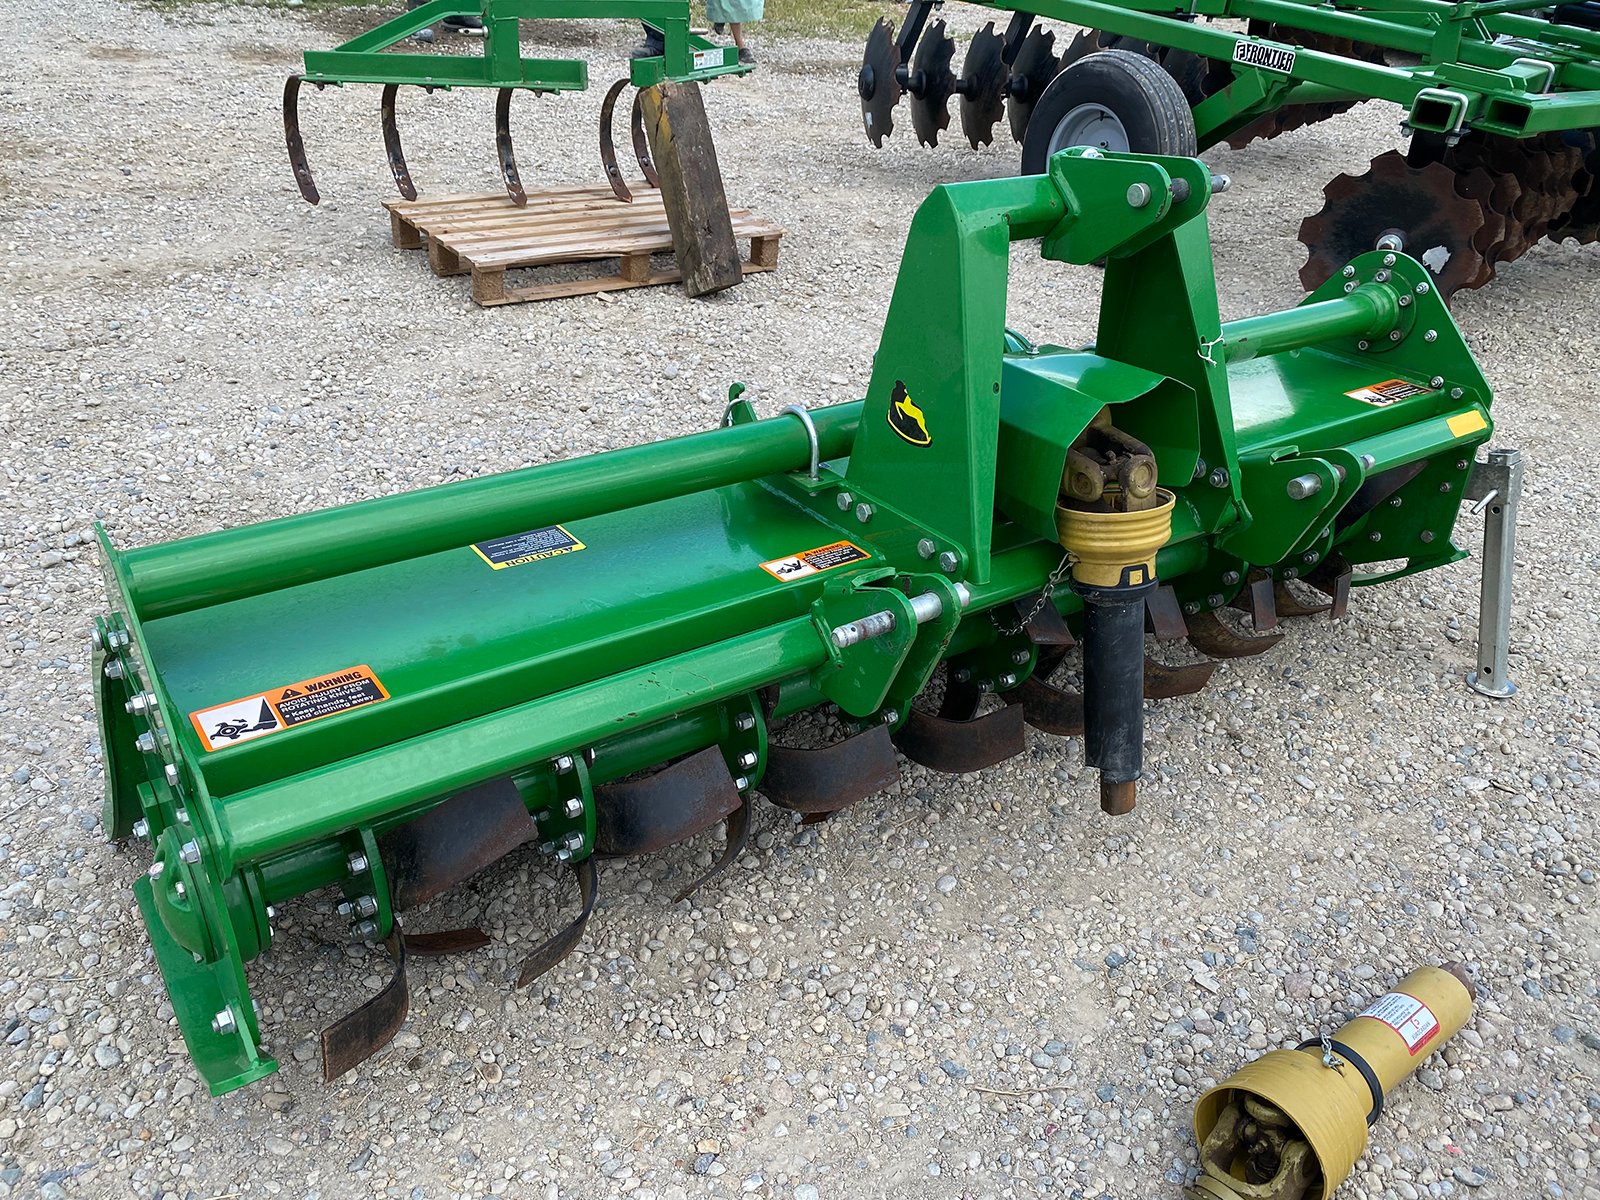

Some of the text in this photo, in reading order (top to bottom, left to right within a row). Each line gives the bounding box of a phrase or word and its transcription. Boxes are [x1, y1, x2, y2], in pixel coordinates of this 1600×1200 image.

[1246, 43, 1294, 72] FRONTIER
[505, 549, 563, 567] CAUTION
[280, 680, 370, 708] AVOID INJURY FROM
[305, 672, 362, 692] WARNING
[281, 686, 363, 713] ROTATING KNIVES
[291, 706, 316, 718] Keep
[348, 692, 366, 701] feet
[294, 694, 374, 721] and clothing away
